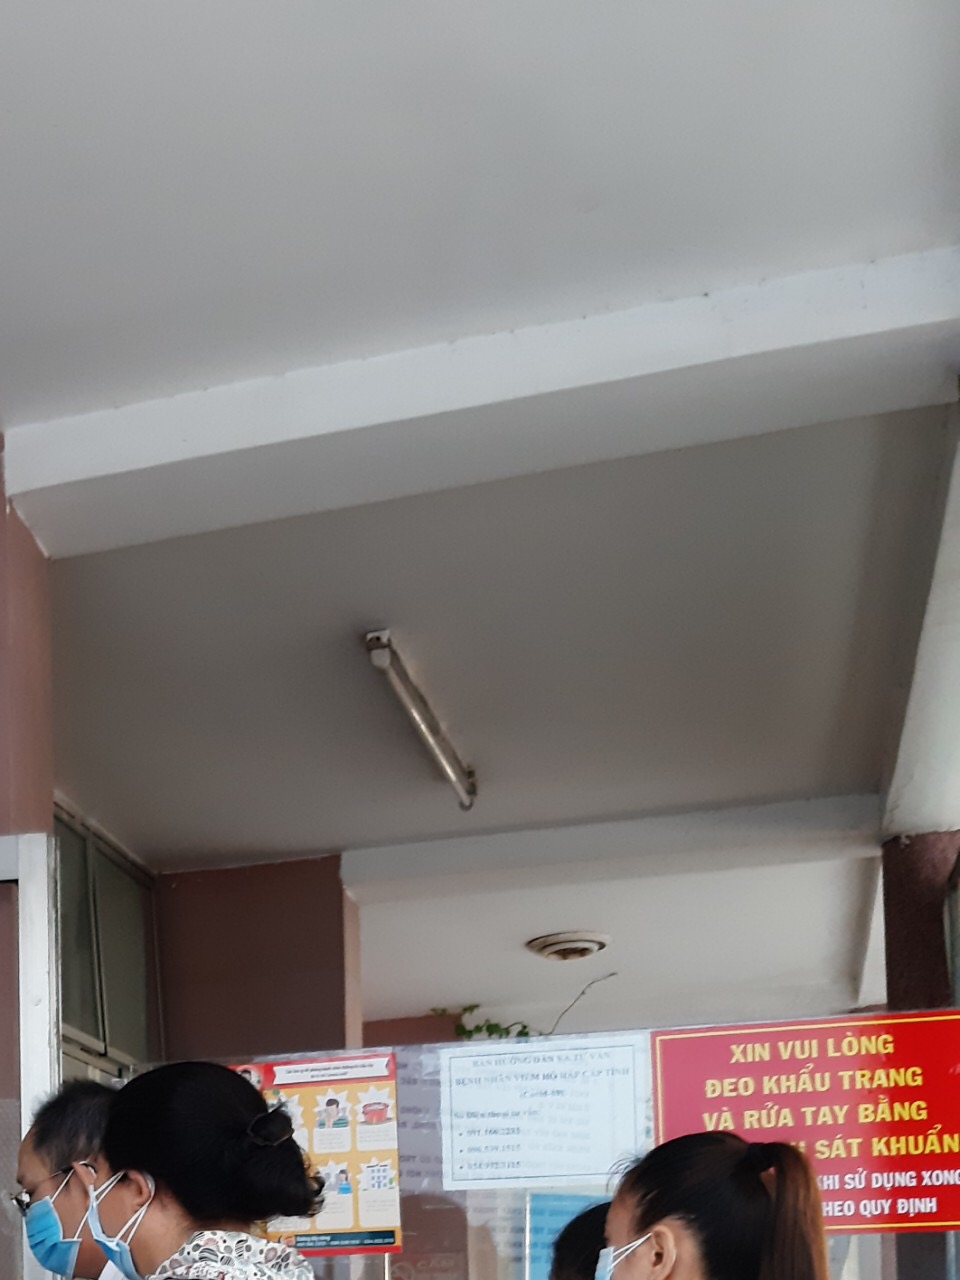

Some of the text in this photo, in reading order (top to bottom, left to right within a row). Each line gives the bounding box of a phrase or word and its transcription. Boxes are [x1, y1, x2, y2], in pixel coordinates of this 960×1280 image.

[729, 1032, 895, 1064] XIN VUI LÒNG
[704, 1063, 924, 1098] ĐEO KHẨU TRANG
[702, 1094, 928, 1131] VÀ RỬA TAY BẰNG
[814, 1123, 960, 1160] SÁT KHUẨN
[844, 1168, 868, 1190] SỬ
[871, 1171, 918, 1191] DỤNG
[821, 1197, 938, 1218] HEO QUY ĐỊNH
